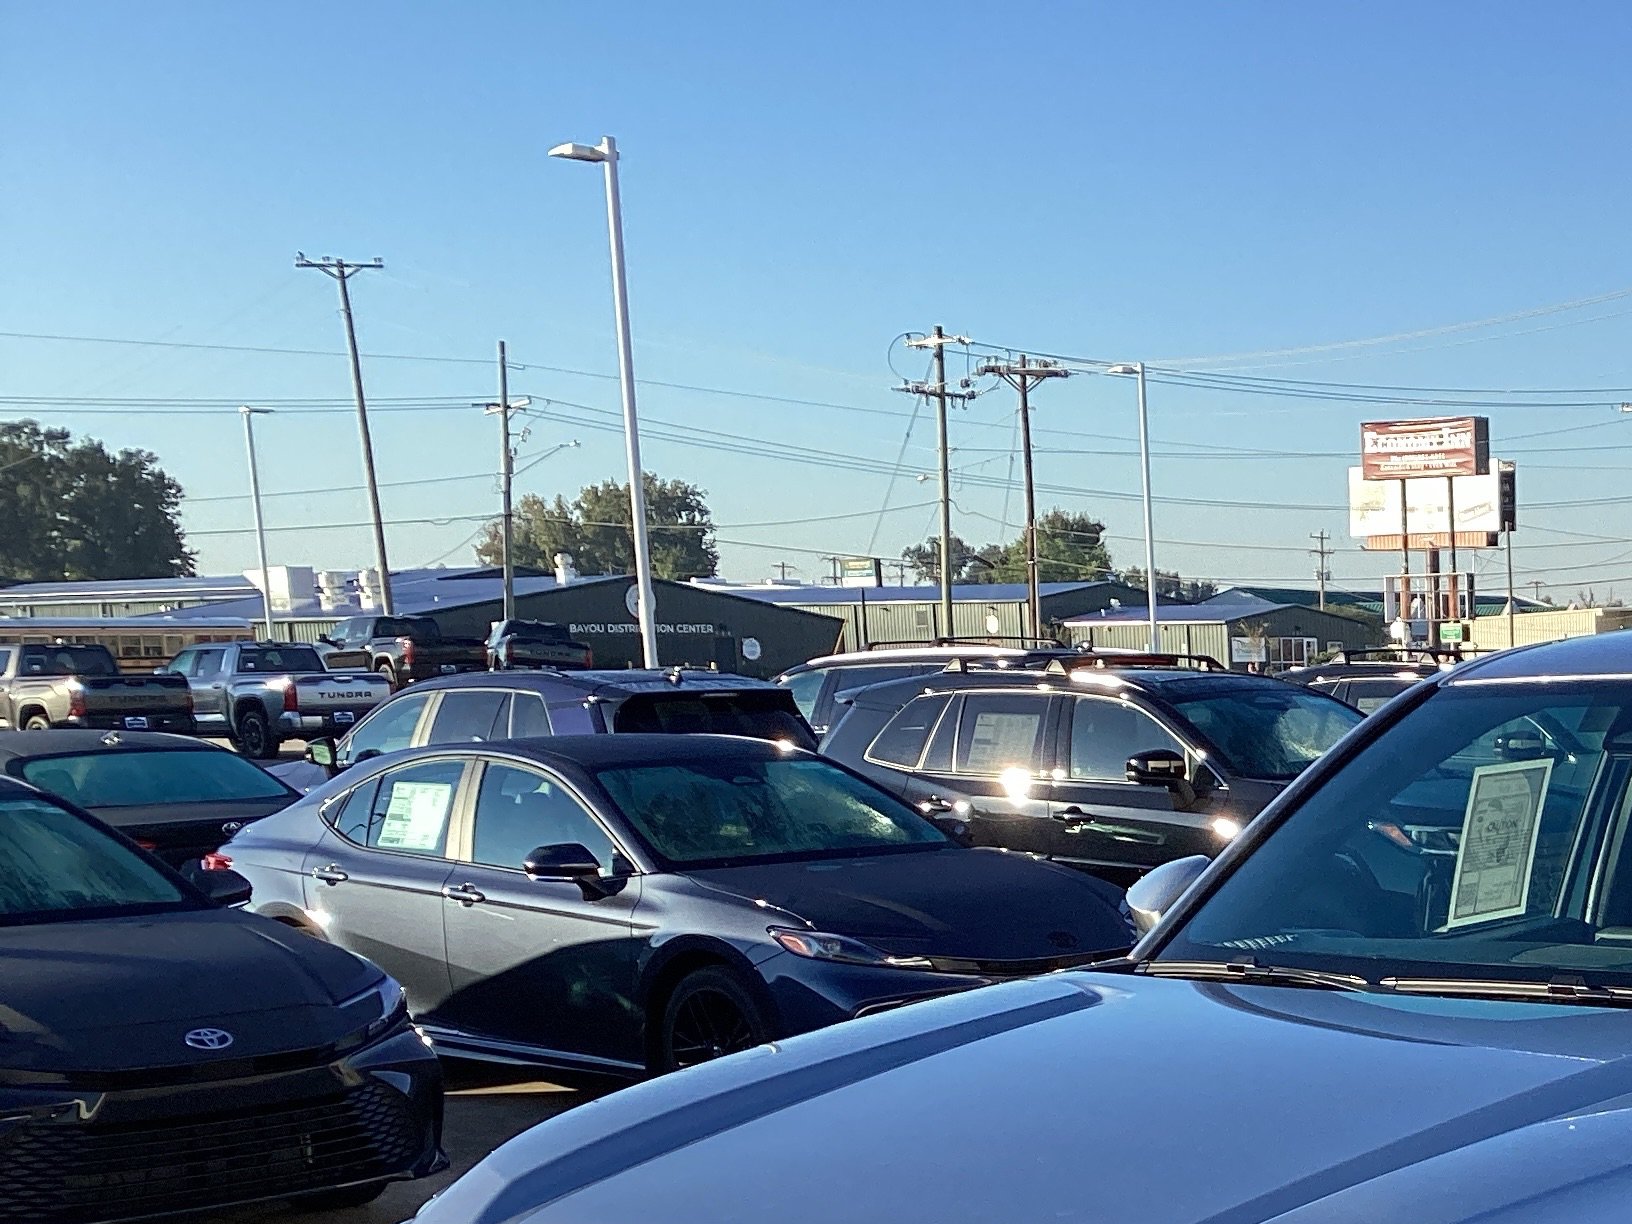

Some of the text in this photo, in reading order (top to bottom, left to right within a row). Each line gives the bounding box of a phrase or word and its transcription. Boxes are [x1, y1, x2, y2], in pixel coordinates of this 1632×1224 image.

[569, 623, 714, 633] BAYOU DISTRIION CENTER
[318, 691, 373, 699] TUNDRA
